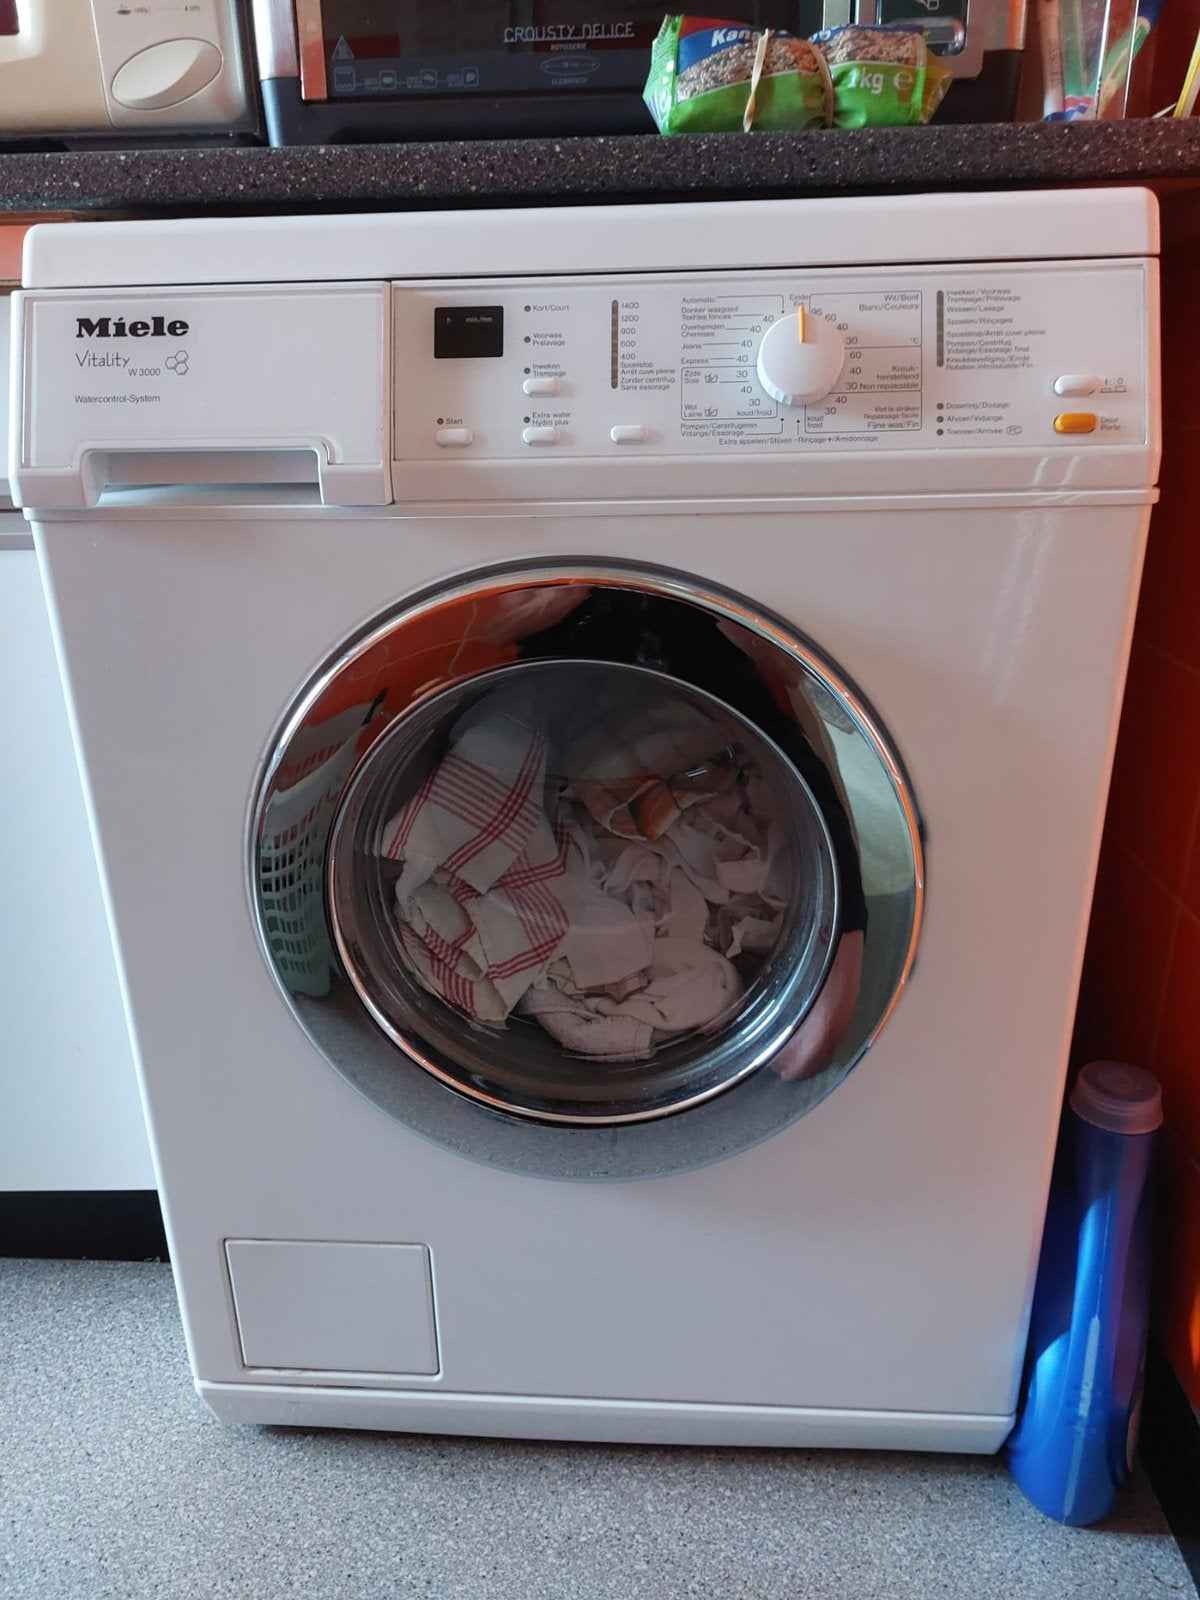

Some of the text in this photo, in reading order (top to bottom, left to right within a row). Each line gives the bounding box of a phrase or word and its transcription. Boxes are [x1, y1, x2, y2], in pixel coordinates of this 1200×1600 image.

[503, 22, 635, 43] CROUSTY DELICE
[848, 68, 884, 94] 1kg
[884, 294, 919, 302] Wit/Bont
[533, 304, 569, 312] Kort/Court
[859, 303, 919, 311] Blanc/Couleurs
[825, 314, 837, 322] 60
[750, 325, 761, 333] 40
[836, 323, 848, 331] 40
[846, 337, 858, 345] 30
[75, 350, 131, 368] Vitality
[850, 351, 862, 359] 60
[681, 357, 708, 365] Express
[139, 368, 160, 376] 3000
[736, 370, 748, 378] 30
[850, 367, 861, 375] 40
[846, 382, 858, 390] 30
[877, 382, 919, 390] repassable
[75, 395, 160, 404] Watercontrol-System
[835, 396, 847, 404] 40
[946, 401, 1009, 410] Dosering/Dosage
[825, 407, 836, 415] 30
[532, 419, 569, 427] Hydro plus
[681, 422, 757, 430] Pompen/Centrifugeren
[739, 436, 793, 445] spoelen/Stijven
